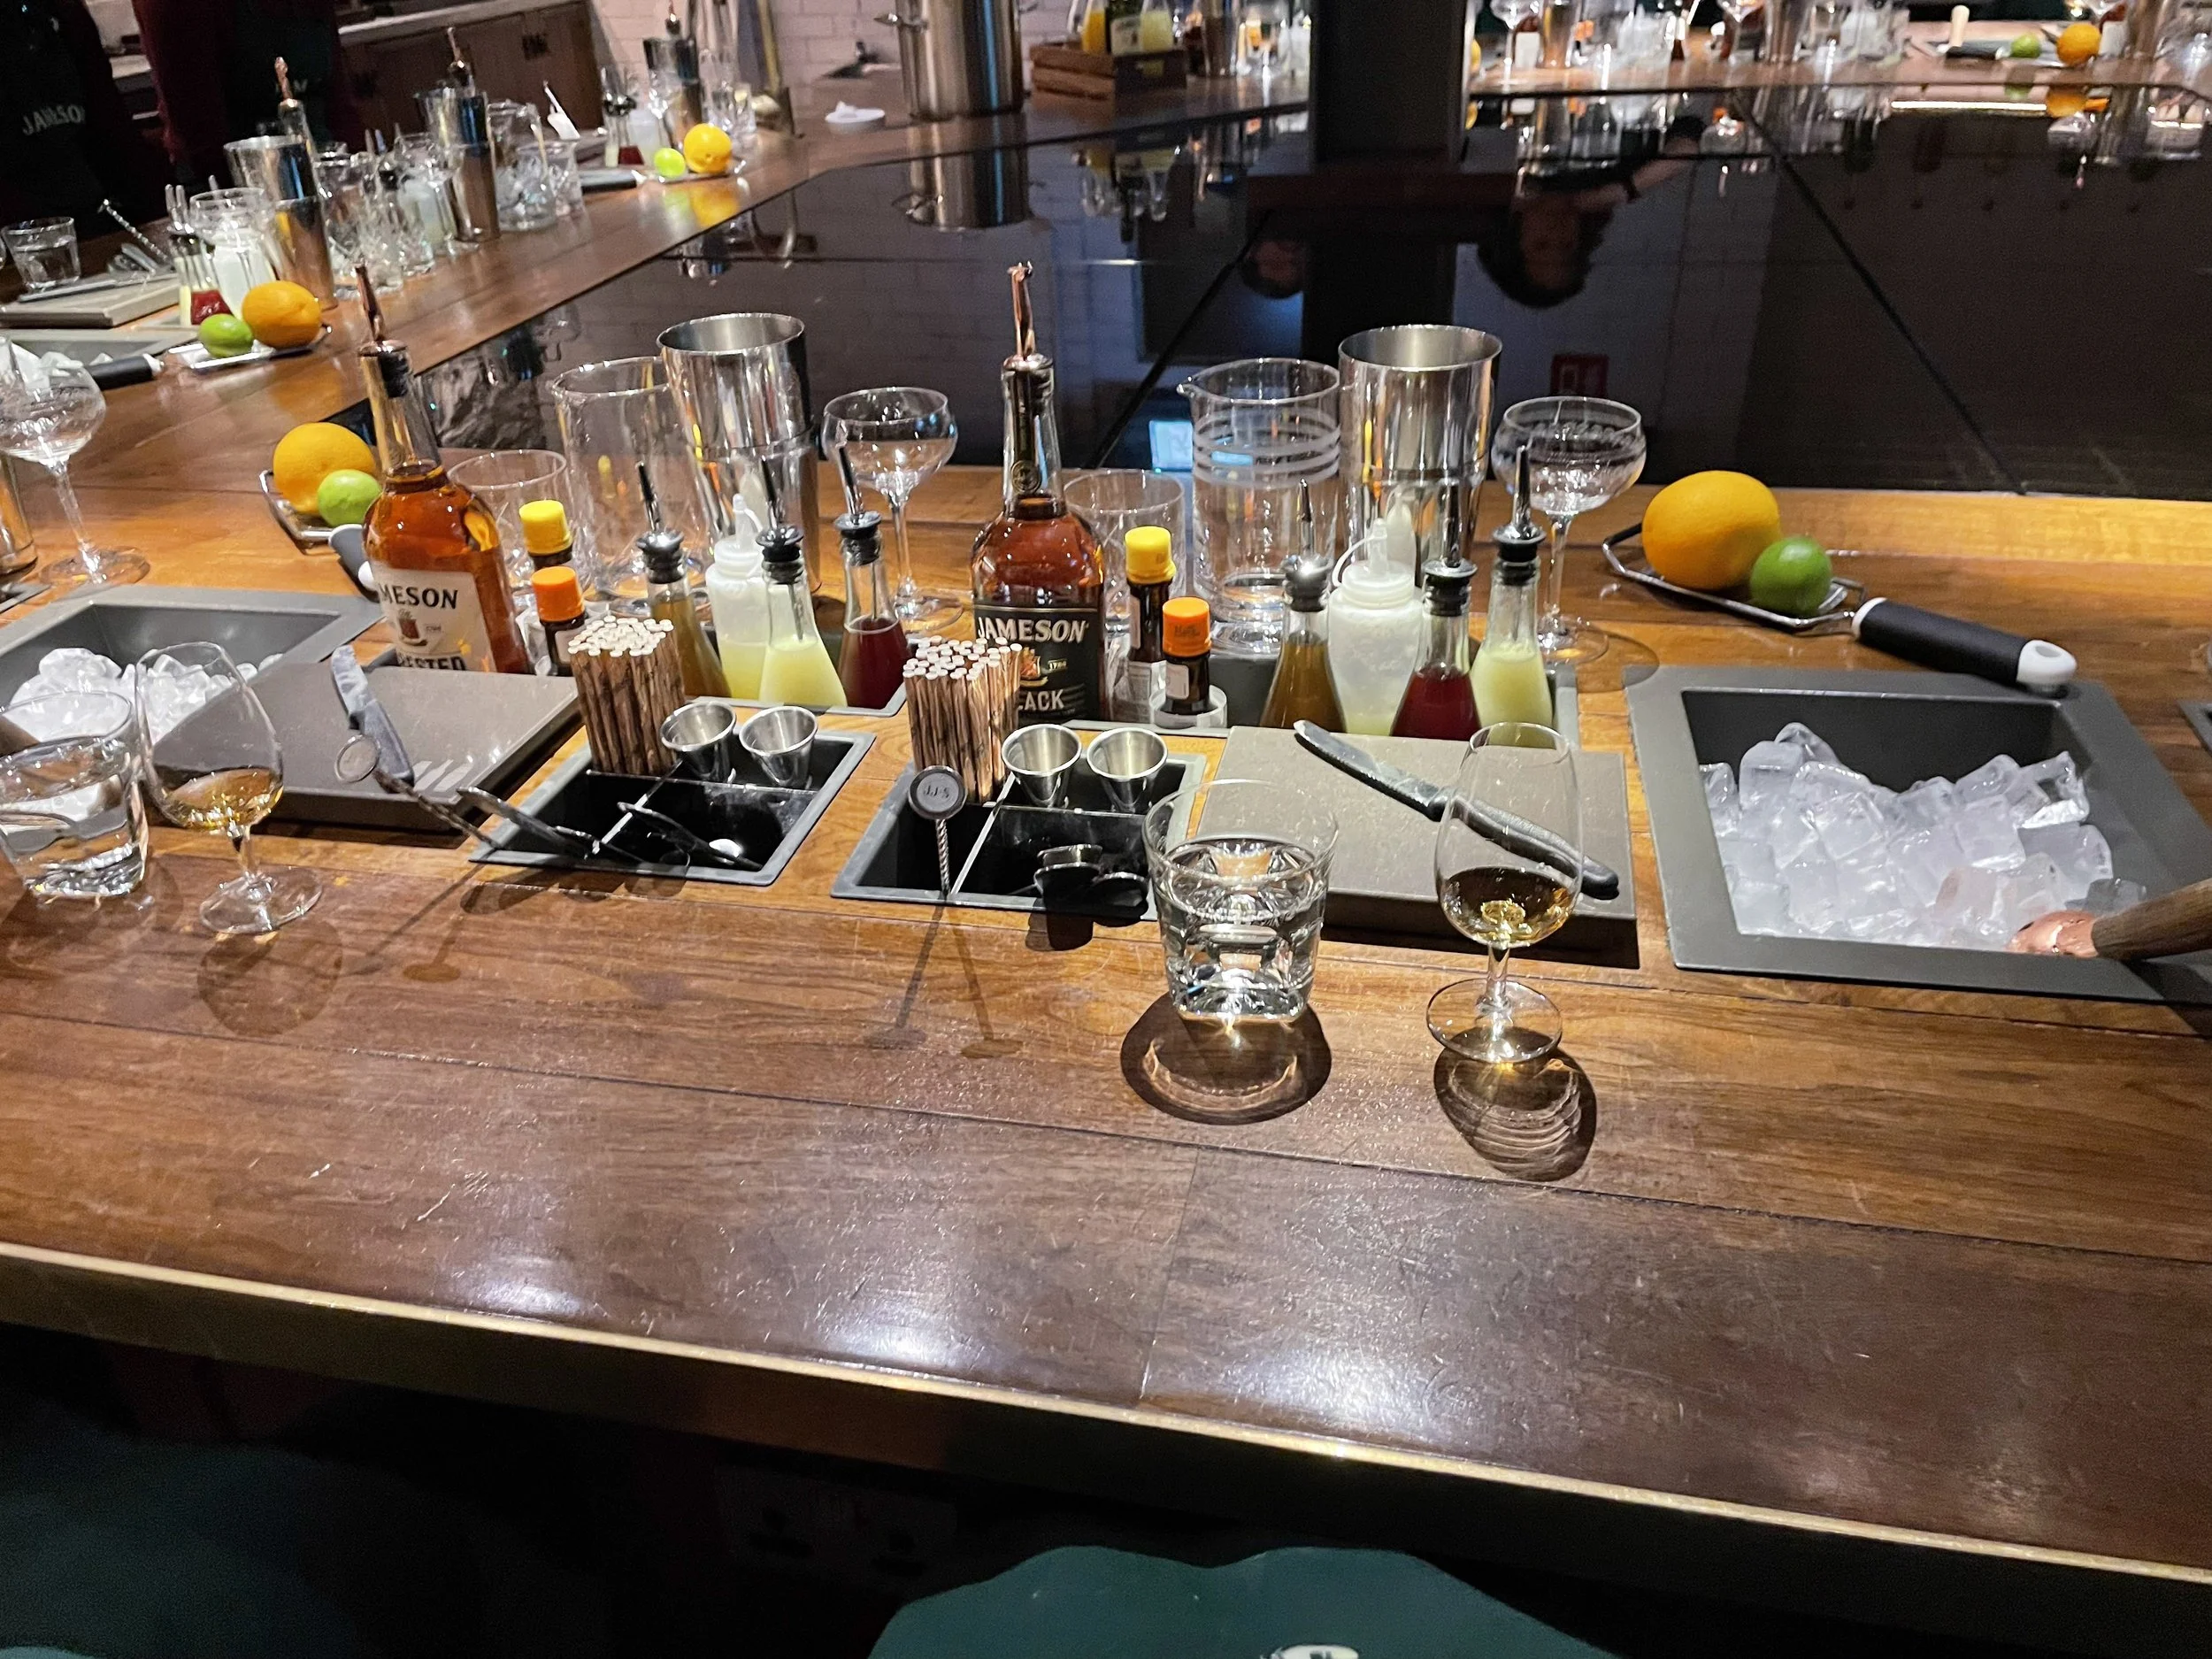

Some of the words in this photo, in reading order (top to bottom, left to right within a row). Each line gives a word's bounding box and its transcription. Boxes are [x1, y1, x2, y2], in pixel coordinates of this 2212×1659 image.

[378, 583, 458, 610] MESON
[978, 616, 1087, 643] JAMESON
[1017, 688, 1065, 712] ACK
